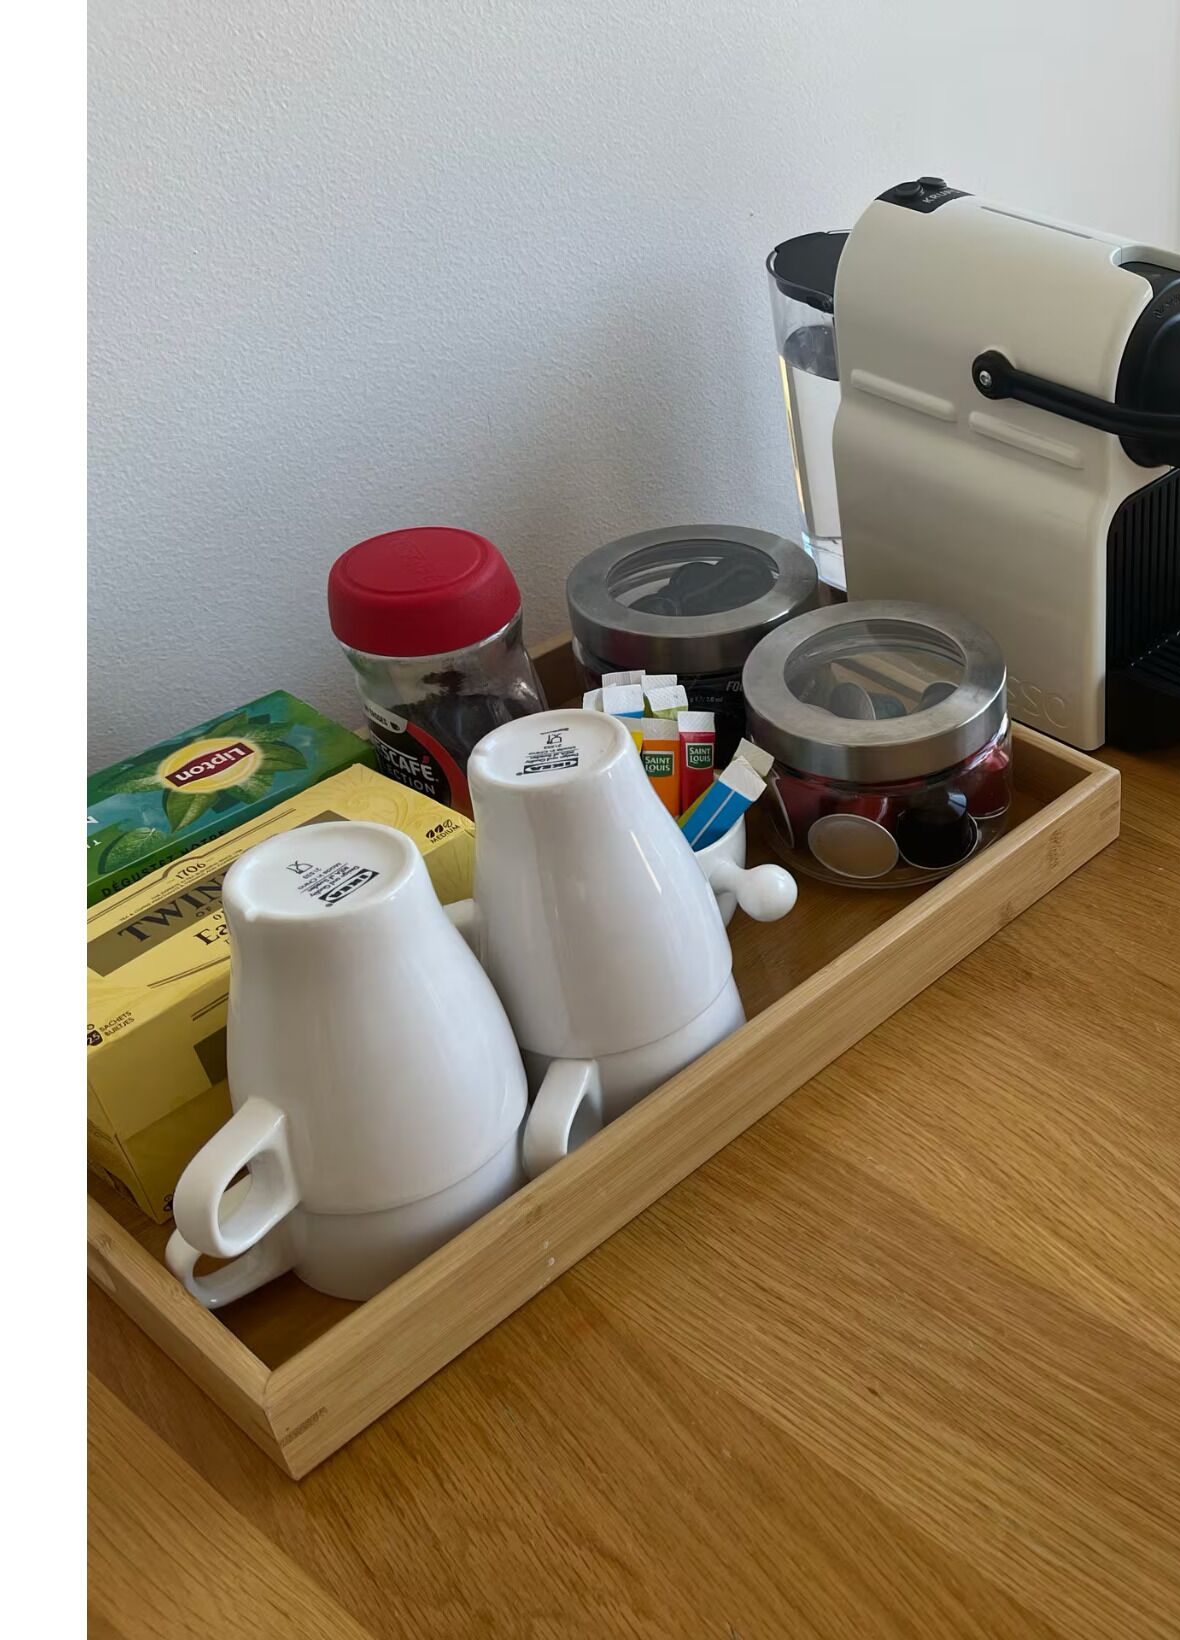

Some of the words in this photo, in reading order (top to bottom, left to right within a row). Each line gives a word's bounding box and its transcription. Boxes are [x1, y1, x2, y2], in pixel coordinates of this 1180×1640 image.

[689, 747, 711, 755] SAINT
[689, 755, 711, 764] LOUIS
[175, 747, 246, 781] Lipton
[375, 741, 435, 781] SCAFÉ
[644, 756, 671, 764] SAINT
[645, 763, 671, 773] LOUIS
[430, 824, 461, 844] MEDIUM
[175, 863, 207, 880] 1706
[98, 1010, 133, 1032] SACHETS
